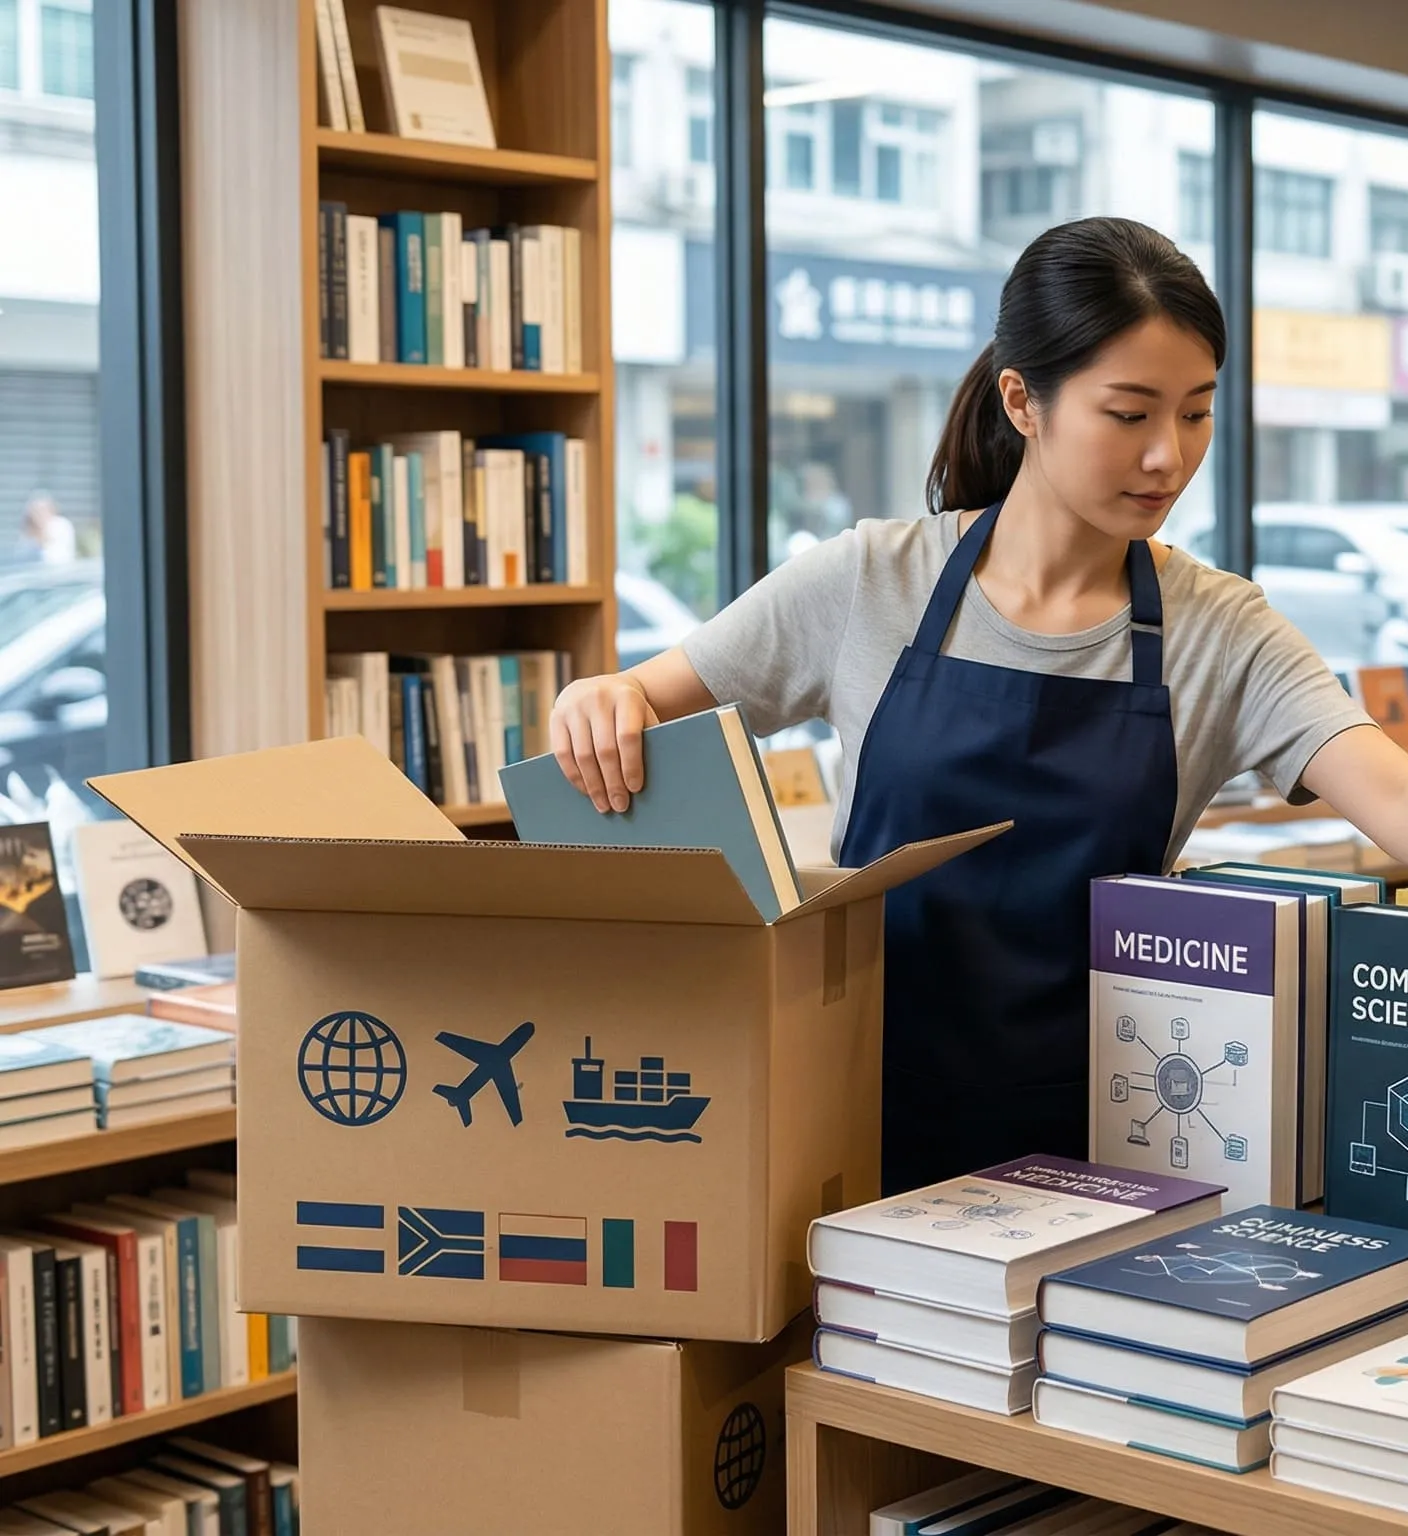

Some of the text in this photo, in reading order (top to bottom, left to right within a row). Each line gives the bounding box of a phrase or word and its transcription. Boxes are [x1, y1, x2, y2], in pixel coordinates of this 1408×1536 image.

[1114, 929, 1249, 975] MEDICINE
[1002, 1169, 1148, 1202] MEDICINE
[1212, 1223, 1341, 1254] SCIENCE
